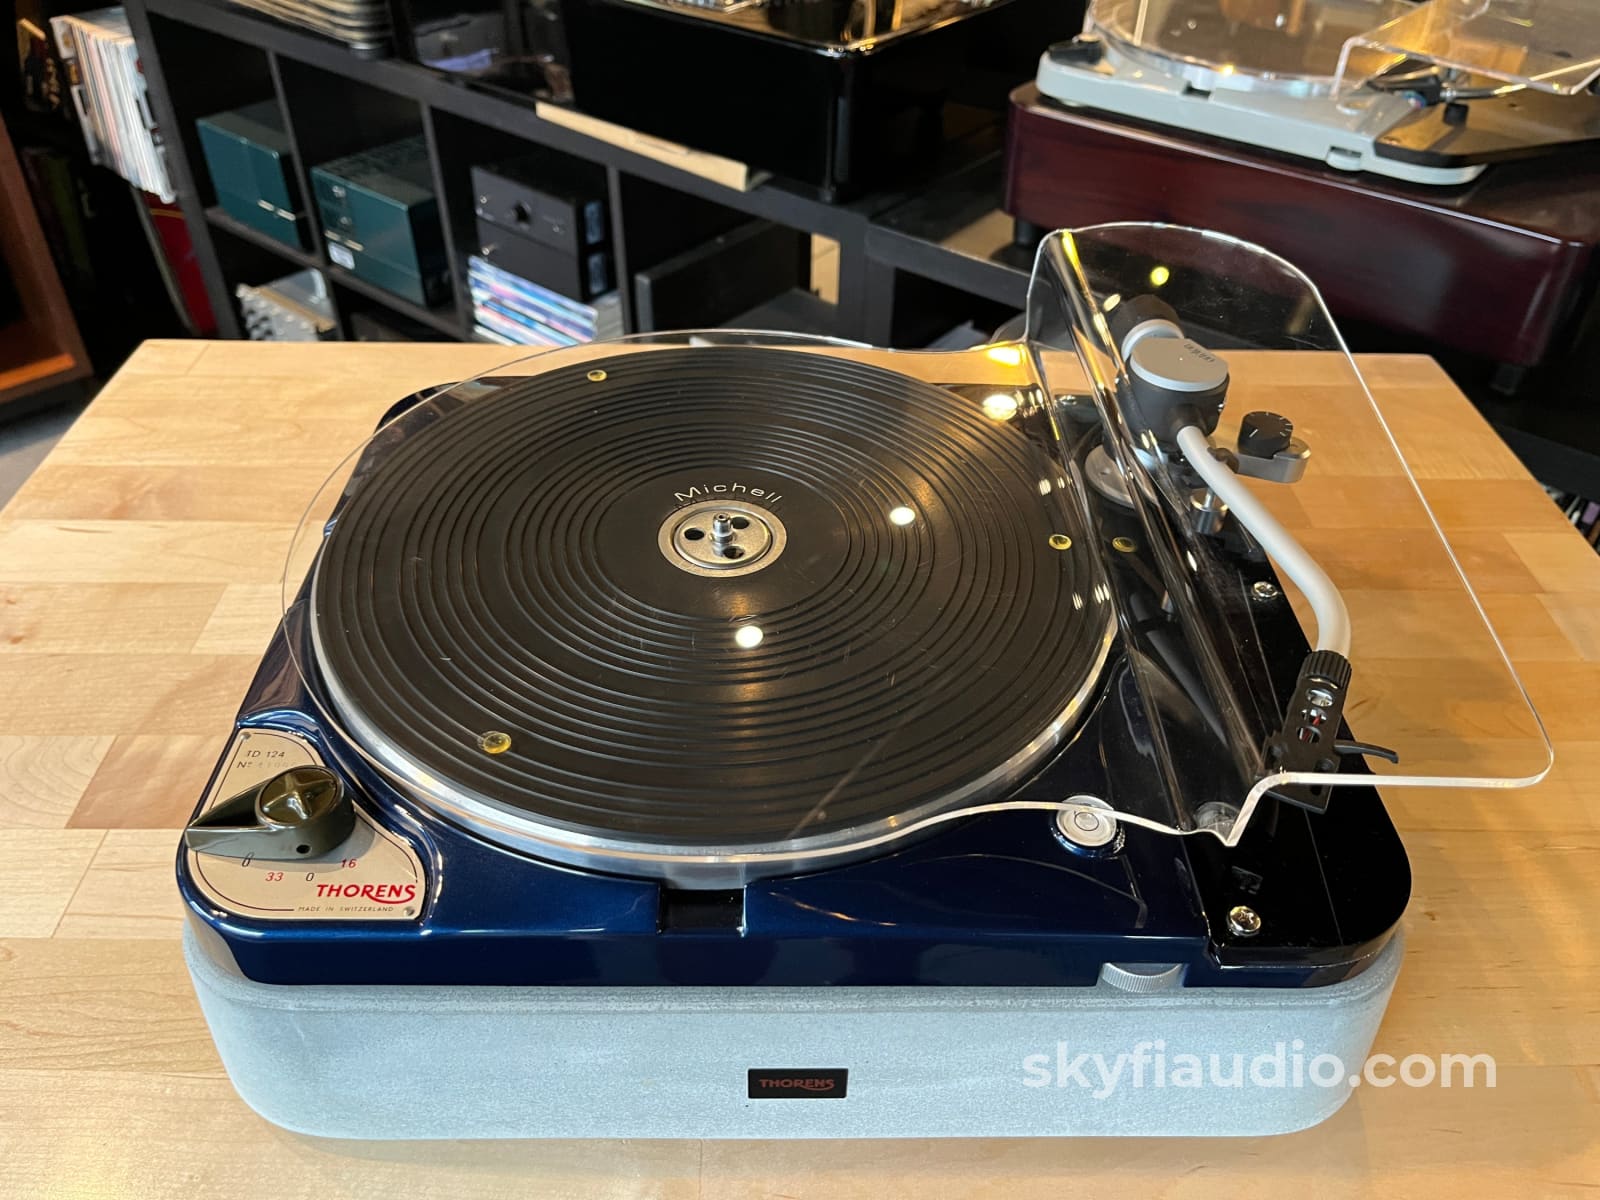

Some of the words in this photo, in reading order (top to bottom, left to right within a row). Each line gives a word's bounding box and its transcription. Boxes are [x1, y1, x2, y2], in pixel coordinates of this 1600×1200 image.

[673, 481, 784, 504] Michell
[246, 750, 261, 758] TD
[265, 750, 286, 758] 124
[264, 872, 284, 882] 33
[340, 858, 357, 869] 16
[316, 884, 417, 905] THORENS
[759, 1078, 836, 1092] THORENS
